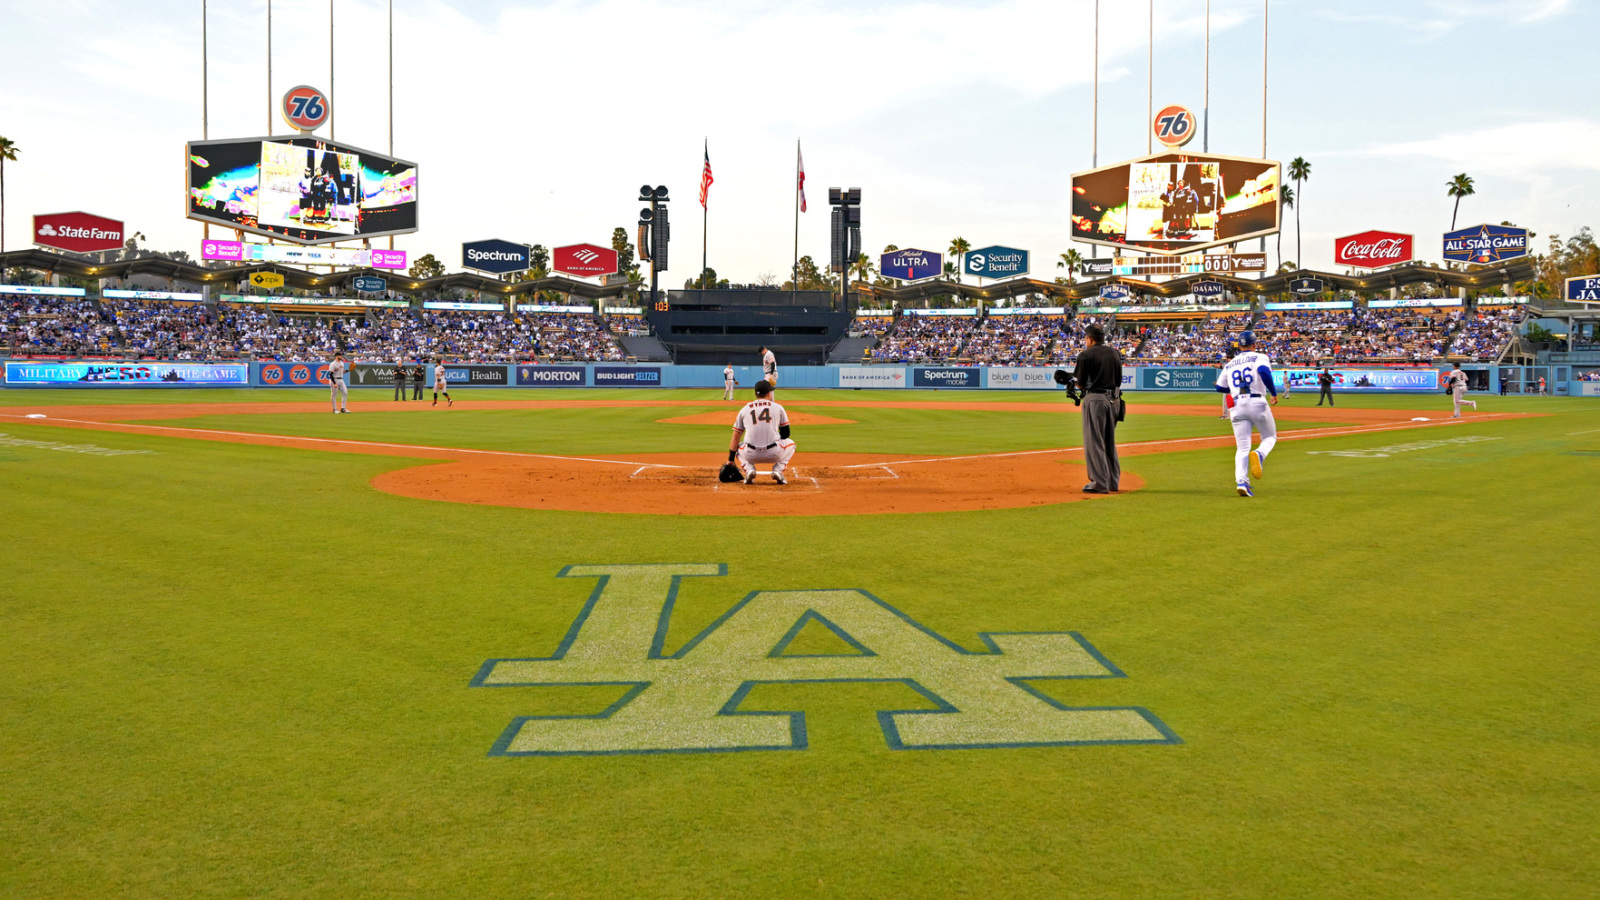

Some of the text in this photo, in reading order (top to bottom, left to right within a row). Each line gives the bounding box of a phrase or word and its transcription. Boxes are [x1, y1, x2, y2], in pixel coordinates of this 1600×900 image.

[290, 95, 325, 120] 76
[1158, 111, 1190, 137] 76
[1493, 237, 1524, 248] GAME
[218, 244, 241, 252] Security
[1341, 238, 1406, 260] Coca-Cola
[467, 249, 521, 262] Spectrum
[988, 253, 1023, 263] Security
[893, 257, 929, 267] ULTRA
[988, 262, 1018, 271] Benefit
[265, 276, 280, 284] cpk
[1193, 285, 1221, 293] DASANI
[1576, 289, 1600, 300] JA
[19, 368, 81, 378] MILITARY
[87, 366, 151, 381] HERO
[202, 369, 237, 378] GAME
[265, 368, 281, 380] 76
[292, 368, 308, 380] 76
[472, 371, 502, 380] Health
[533, 371, 580, 381] MORTON
[635, 372, 658, 381] SELTZER
[924, 370, 966, 380] Spectrum
[991, 373, 1010, 381] blue
[1024, 373, 1043, 381] blue
[1172, 371, 1204, 380] Security
[1232, 367, 1253, 387] 86
[1172, 379, 1200, 387] Benefit
[1393, 375, 1428, 384] GAME
[748, 401, 772, 409] WYNNS
[750, 407, 772, 425] 14
[469, 562, 1184, 757] LA
